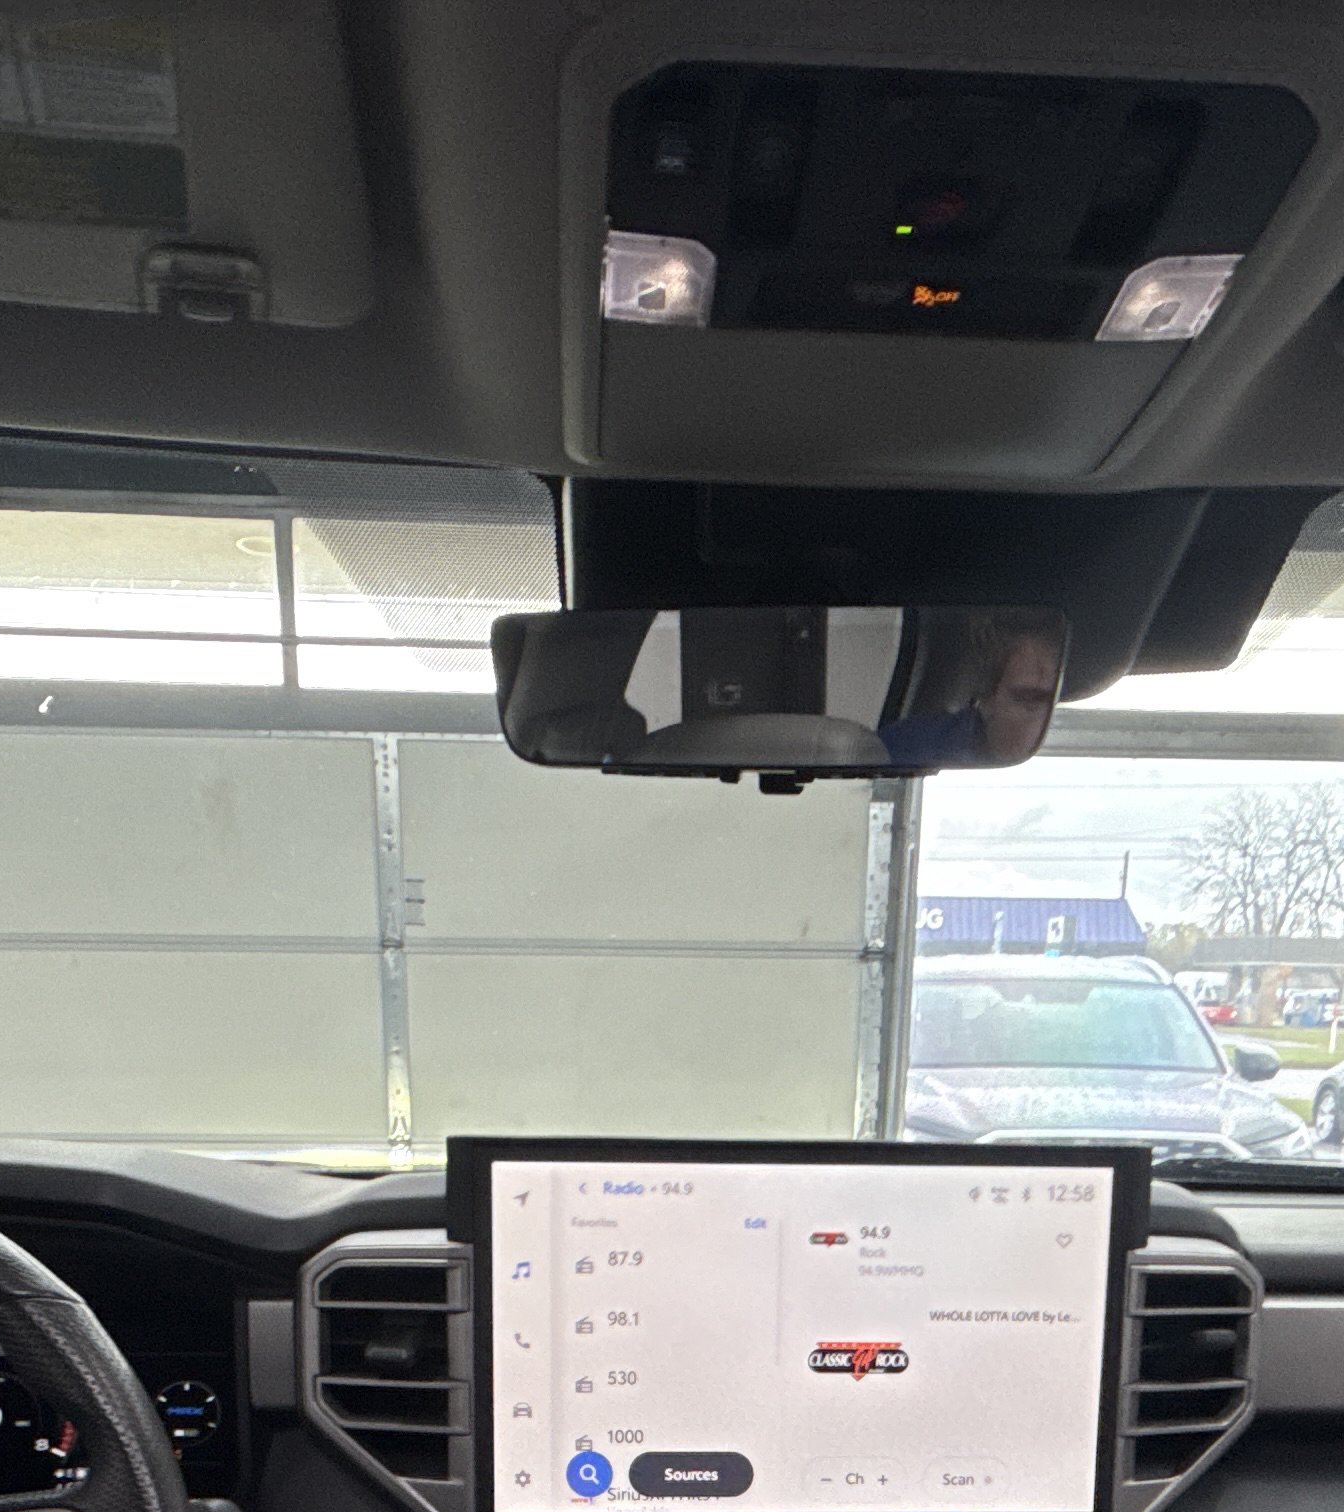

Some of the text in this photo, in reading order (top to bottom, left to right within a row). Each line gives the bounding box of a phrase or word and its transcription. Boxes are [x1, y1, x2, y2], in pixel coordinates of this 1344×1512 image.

[602, 1181, 694, 1195] Radio 94.9
[1047, 1184, 1095, 1201] 12:58
[744, 1217, 767, 1229] Edit
[859, 1226, 891, 1240] 94.9
[607, 1250, 643, 1266] 87.9
[859, 1247, 886, 1258] Rock
[607, 1311, 639, 1326] 98.1
[929, 1310, 972, 1322] WHOLE
[974, 1310, 1007, 1322] LOTTA
[1011, 1310, 1040, 1322] LOVE
[1042, 1310, 1055, 1324] by
[809, 1353, 852, 1367] CLASSIC
[875, 1353, 907, 1367] ROCK
[607, 1371, 637, 1386] 530
[607, 1429, 644, 1444] 1000
[664, 1467, 719, 1482] Sources
[845, 1472, 864, 1486] Ch
[942, 1473, 974, 1486] Scan
